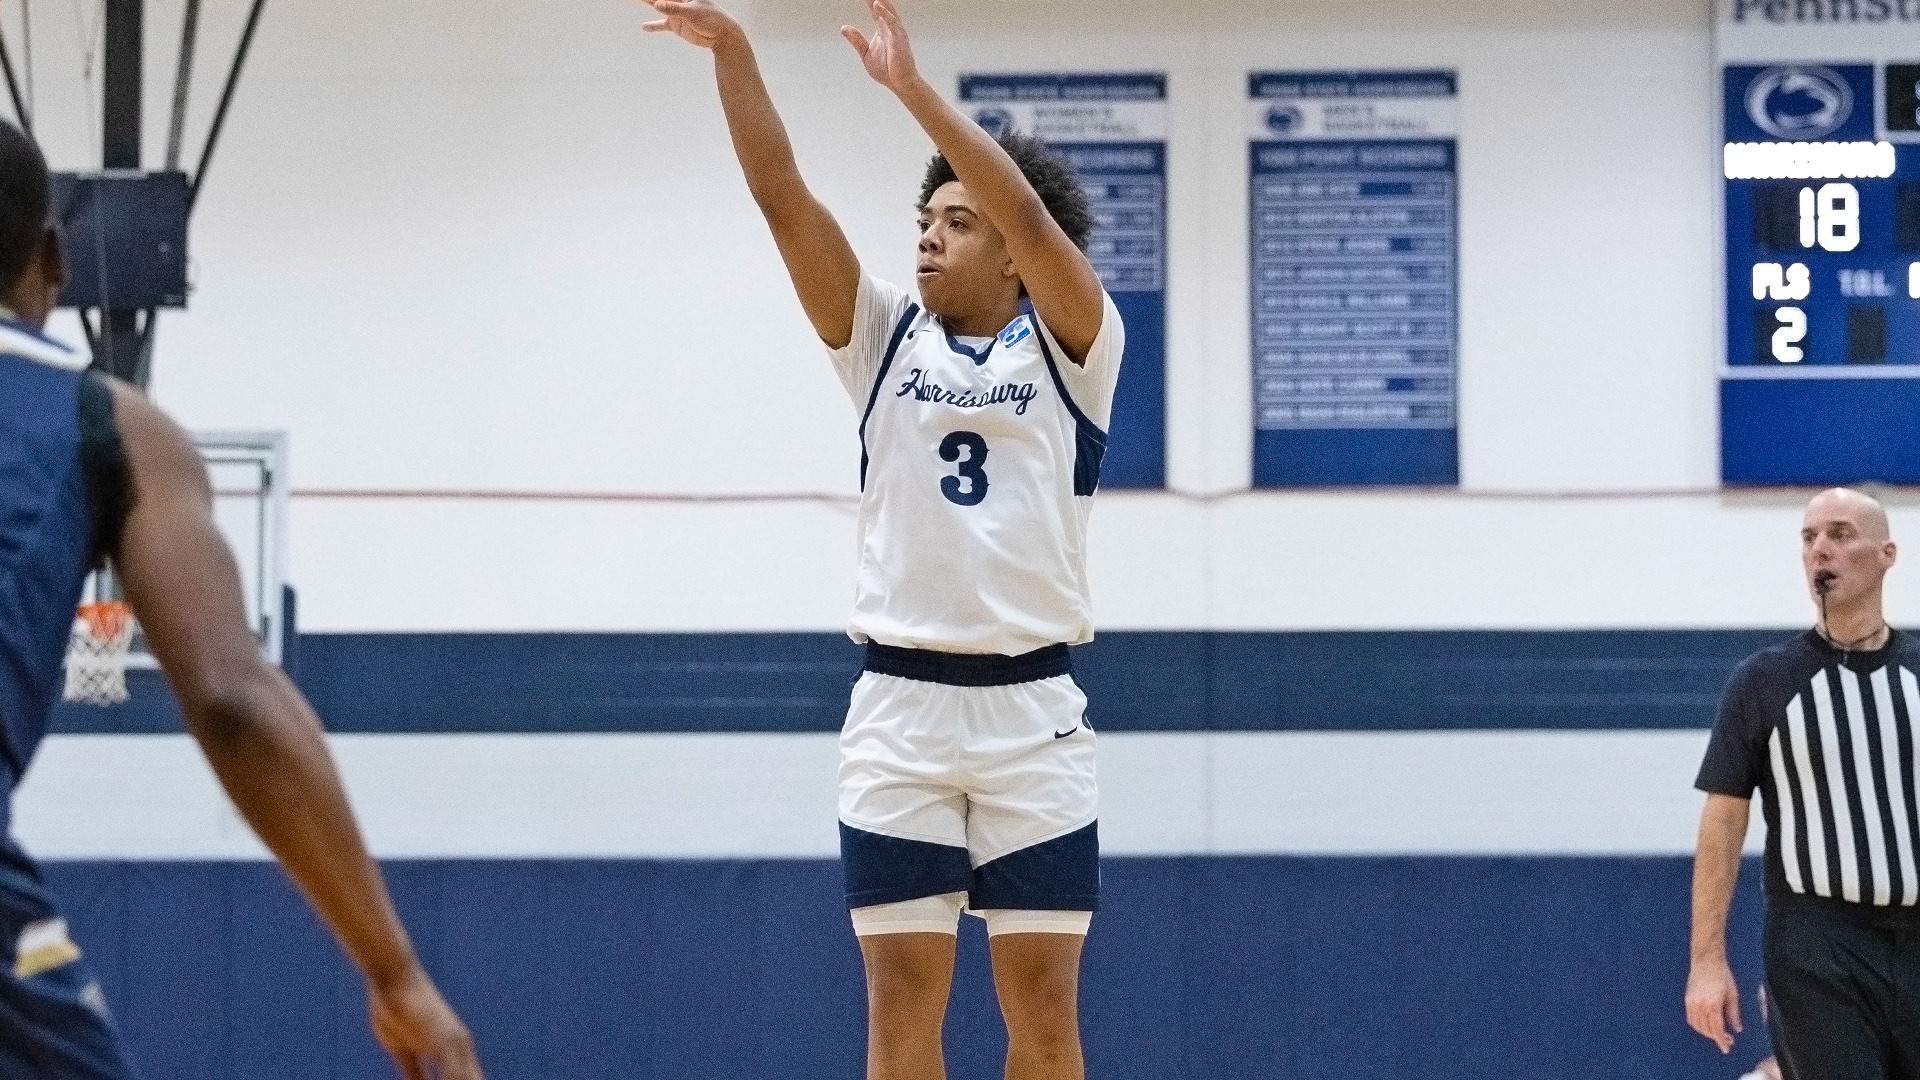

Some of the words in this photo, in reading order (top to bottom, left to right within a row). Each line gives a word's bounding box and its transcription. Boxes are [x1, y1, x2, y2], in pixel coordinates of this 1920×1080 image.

[1732, 0, 1920, 24] PennSt
[1799, 183, 1860, 251] 18
[1772, 306, 1807, 362] 2
[938, 430, 990, 506] 3
